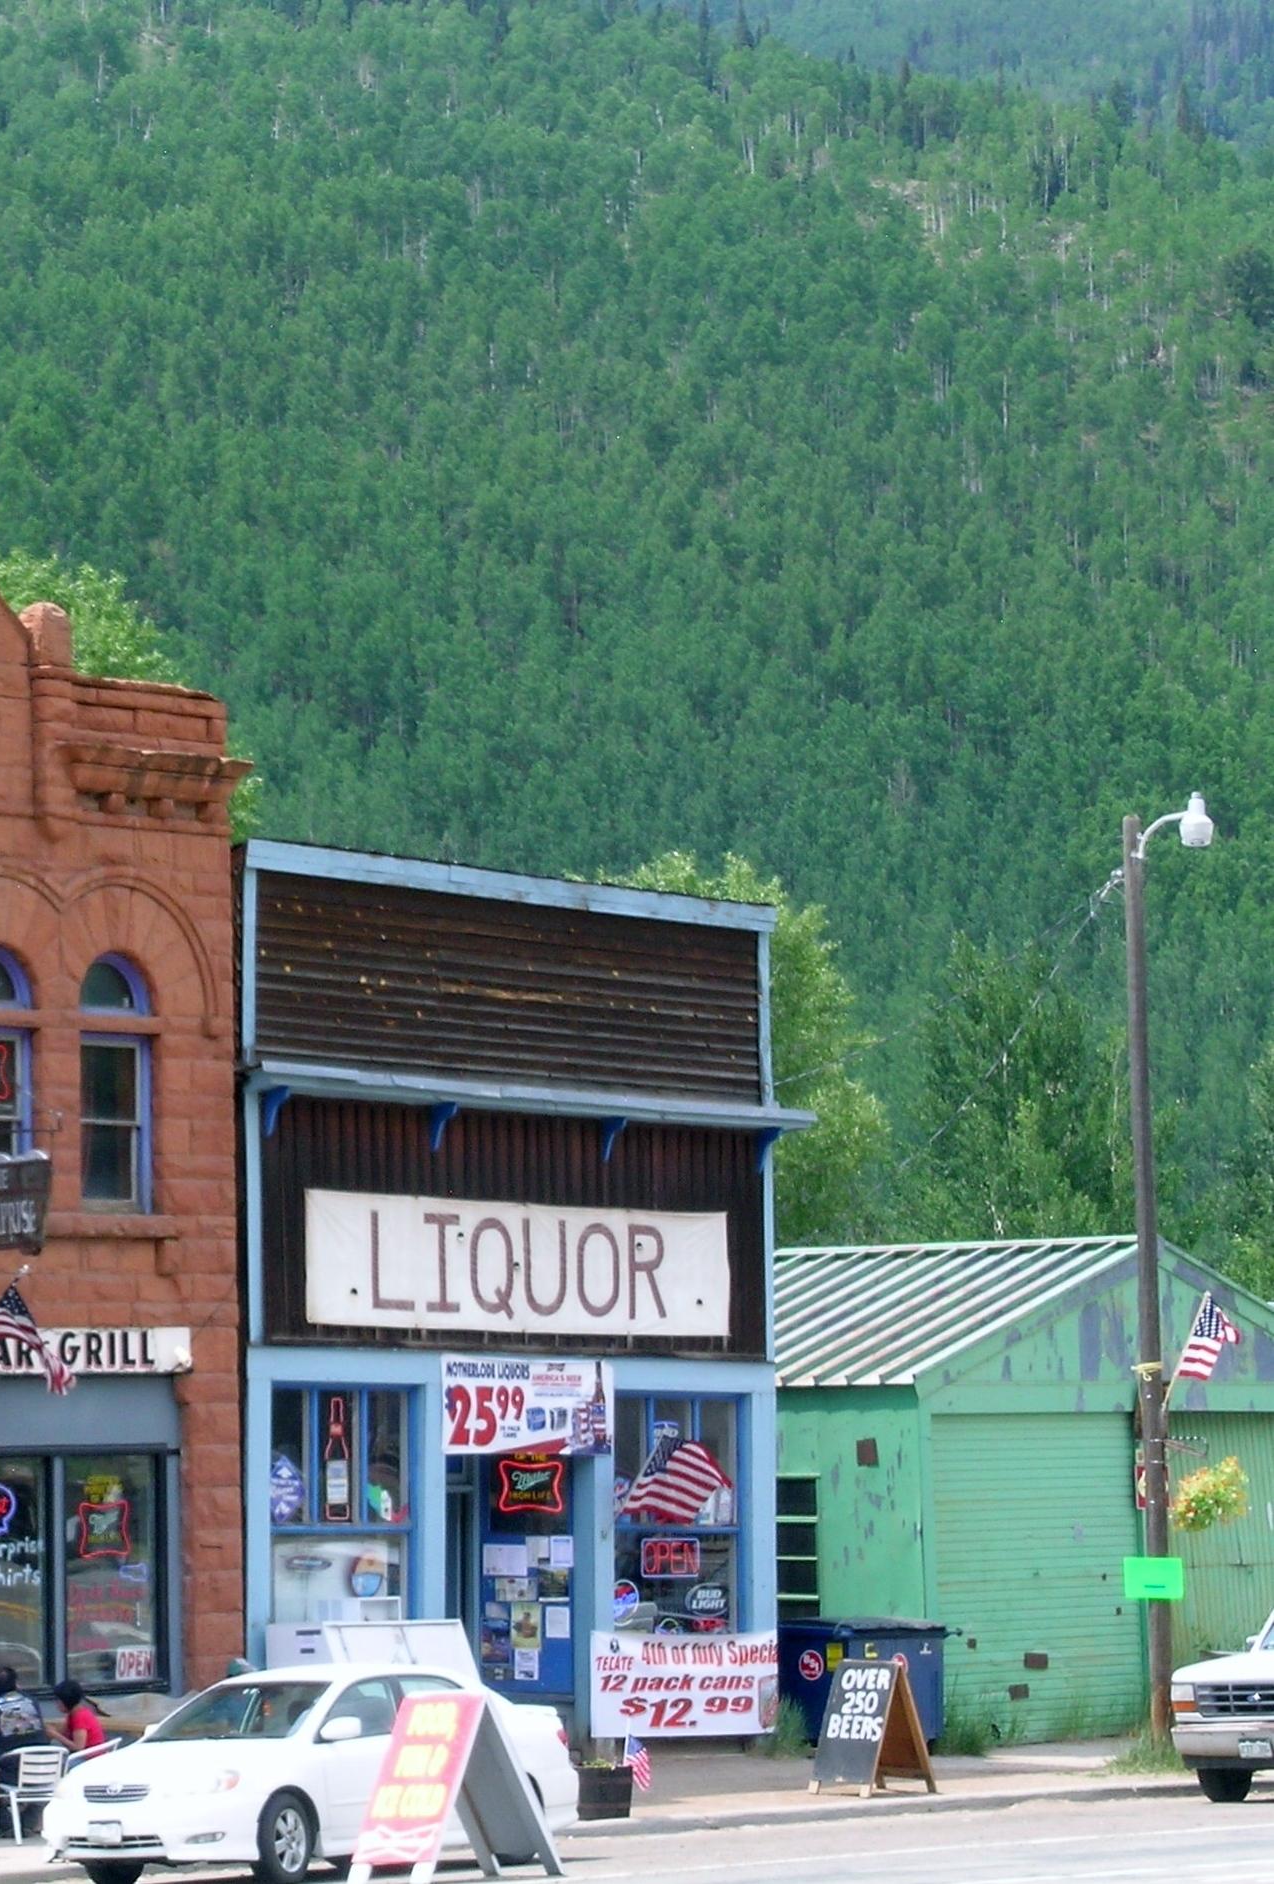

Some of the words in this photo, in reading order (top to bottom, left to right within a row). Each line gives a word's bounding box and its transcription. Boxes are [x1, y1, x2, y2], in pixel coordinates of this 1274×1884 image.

[371, 1209, 667, 1320] LIQUOR
[59, 1331, 155, 1367] GRILL
[497, 1362, 530, 1380] LIQUORS
[645, 1543, 699, 1572] OPEN
[691, 1599, 726, 1610] LIGHT
[696, 1589, 722, 1600] BUD
[118, 1649, 152, 1678] OPEN
[596, 1655, 634, 1671] TECATE
[642, 1641, 667, 1664] 4th
[671, 1643, 691, 1664] of
[692, 1642, 723, 1666] July
[600, 1674, 628, 1692] 12
[631, 1674, 695, 1693] pack
[698, 1675, 755, 1691] cans
[841, 1668, 892, 1690] OVER
[841, 1691, 879, 1714] 250
[826, 1713, 884, 1742] BEERS
